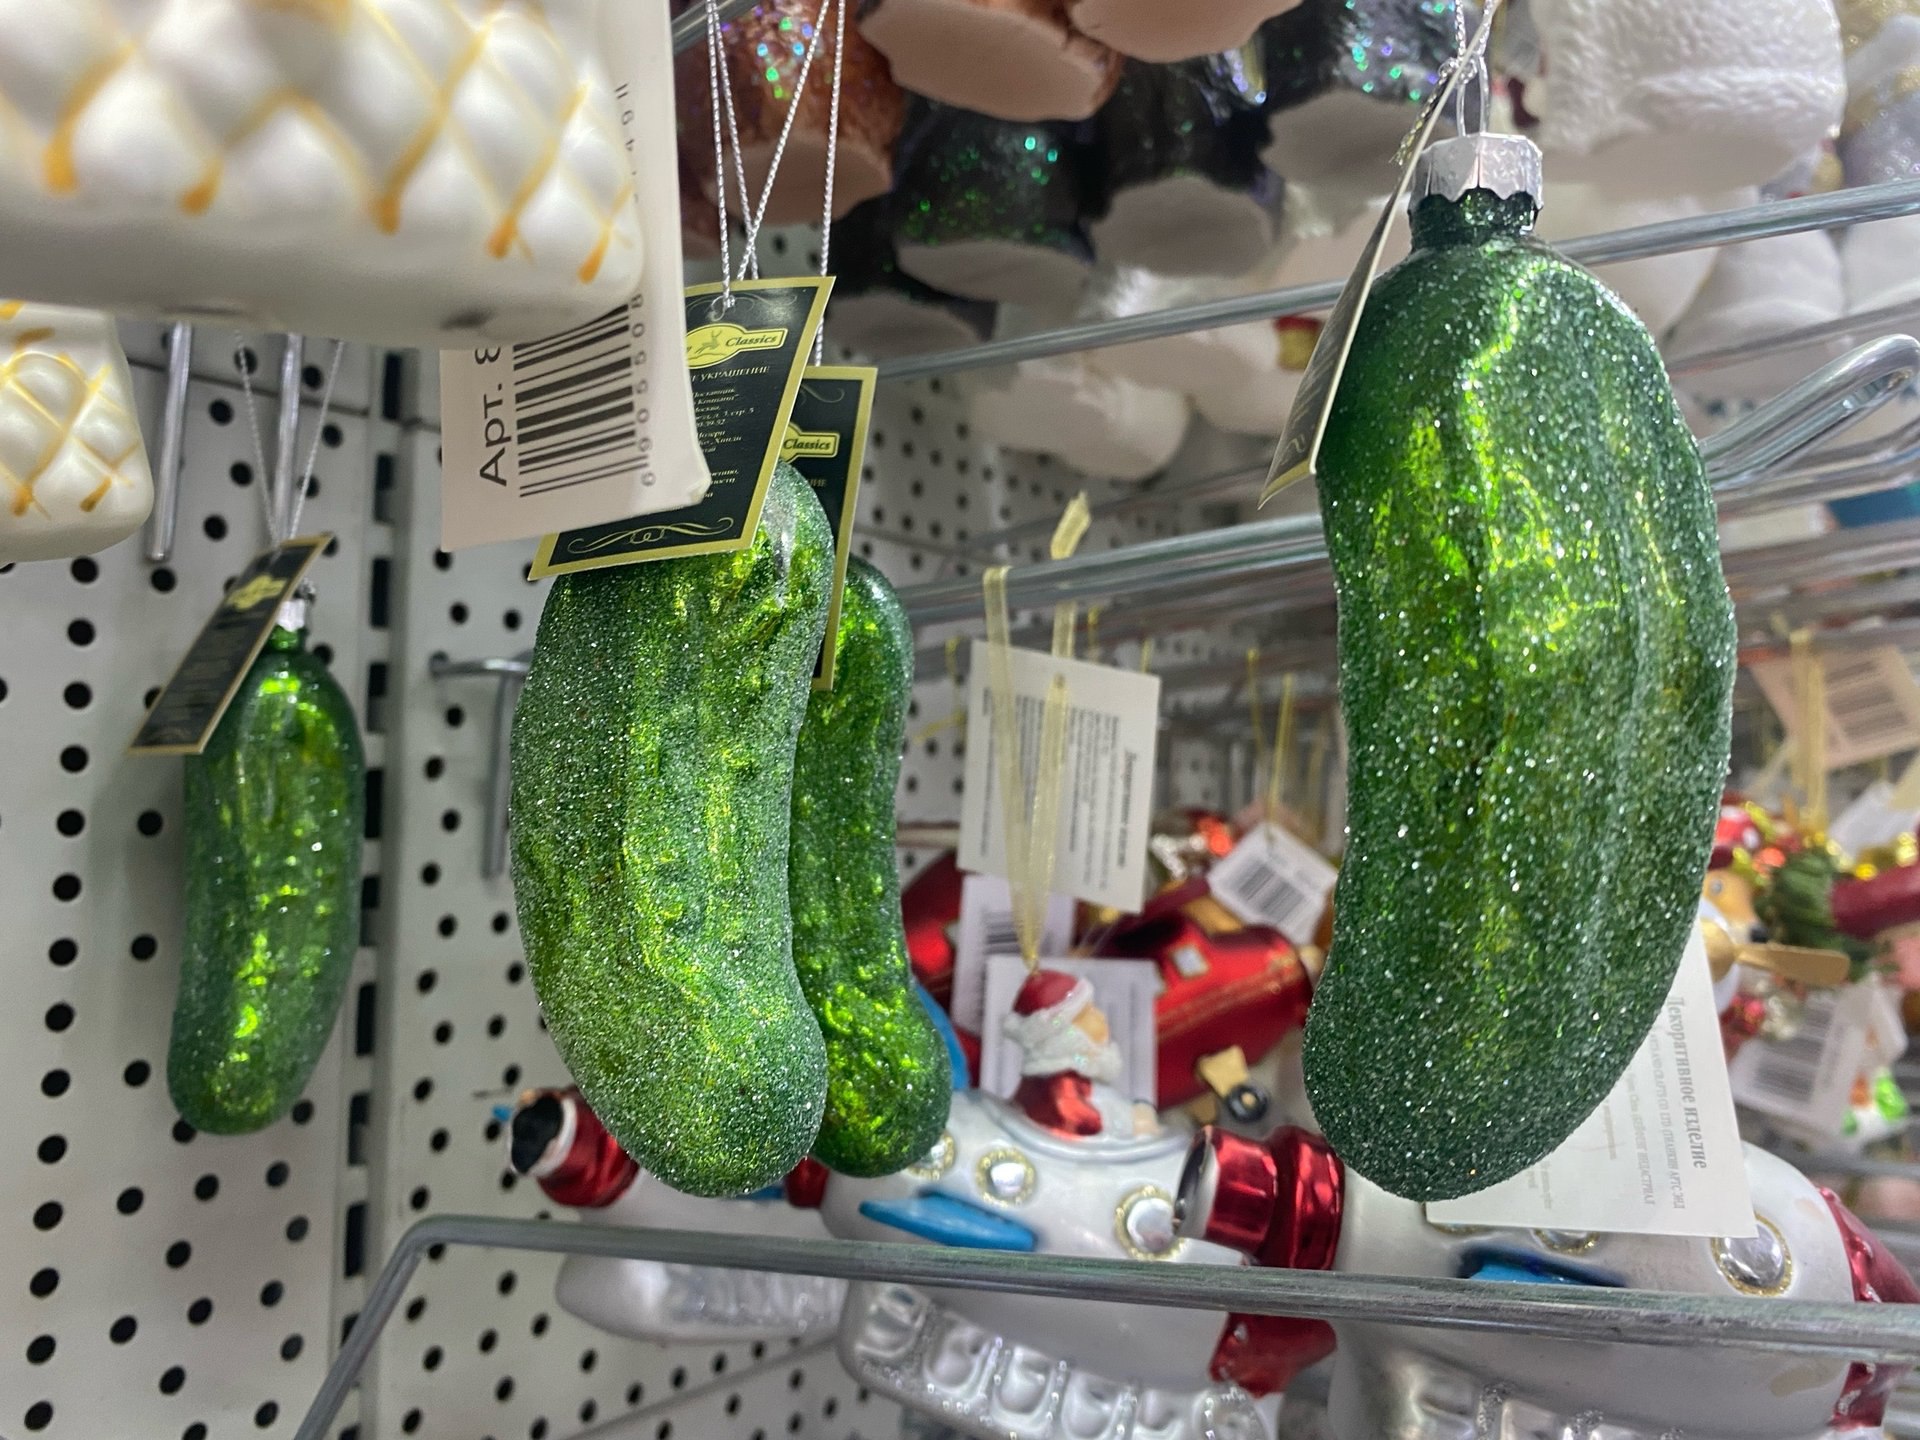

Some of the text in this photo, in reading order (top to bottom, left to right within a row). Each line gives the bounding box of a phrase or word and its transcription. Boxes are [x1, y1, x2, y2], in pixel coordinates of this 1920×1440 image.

[726, 335, 778, 347] Classics
[479, 383, 512, 487] Арт.
[783, 438, 831, 450] Classics
[1666, 997, 1707, 1168] Декоративное изделие
